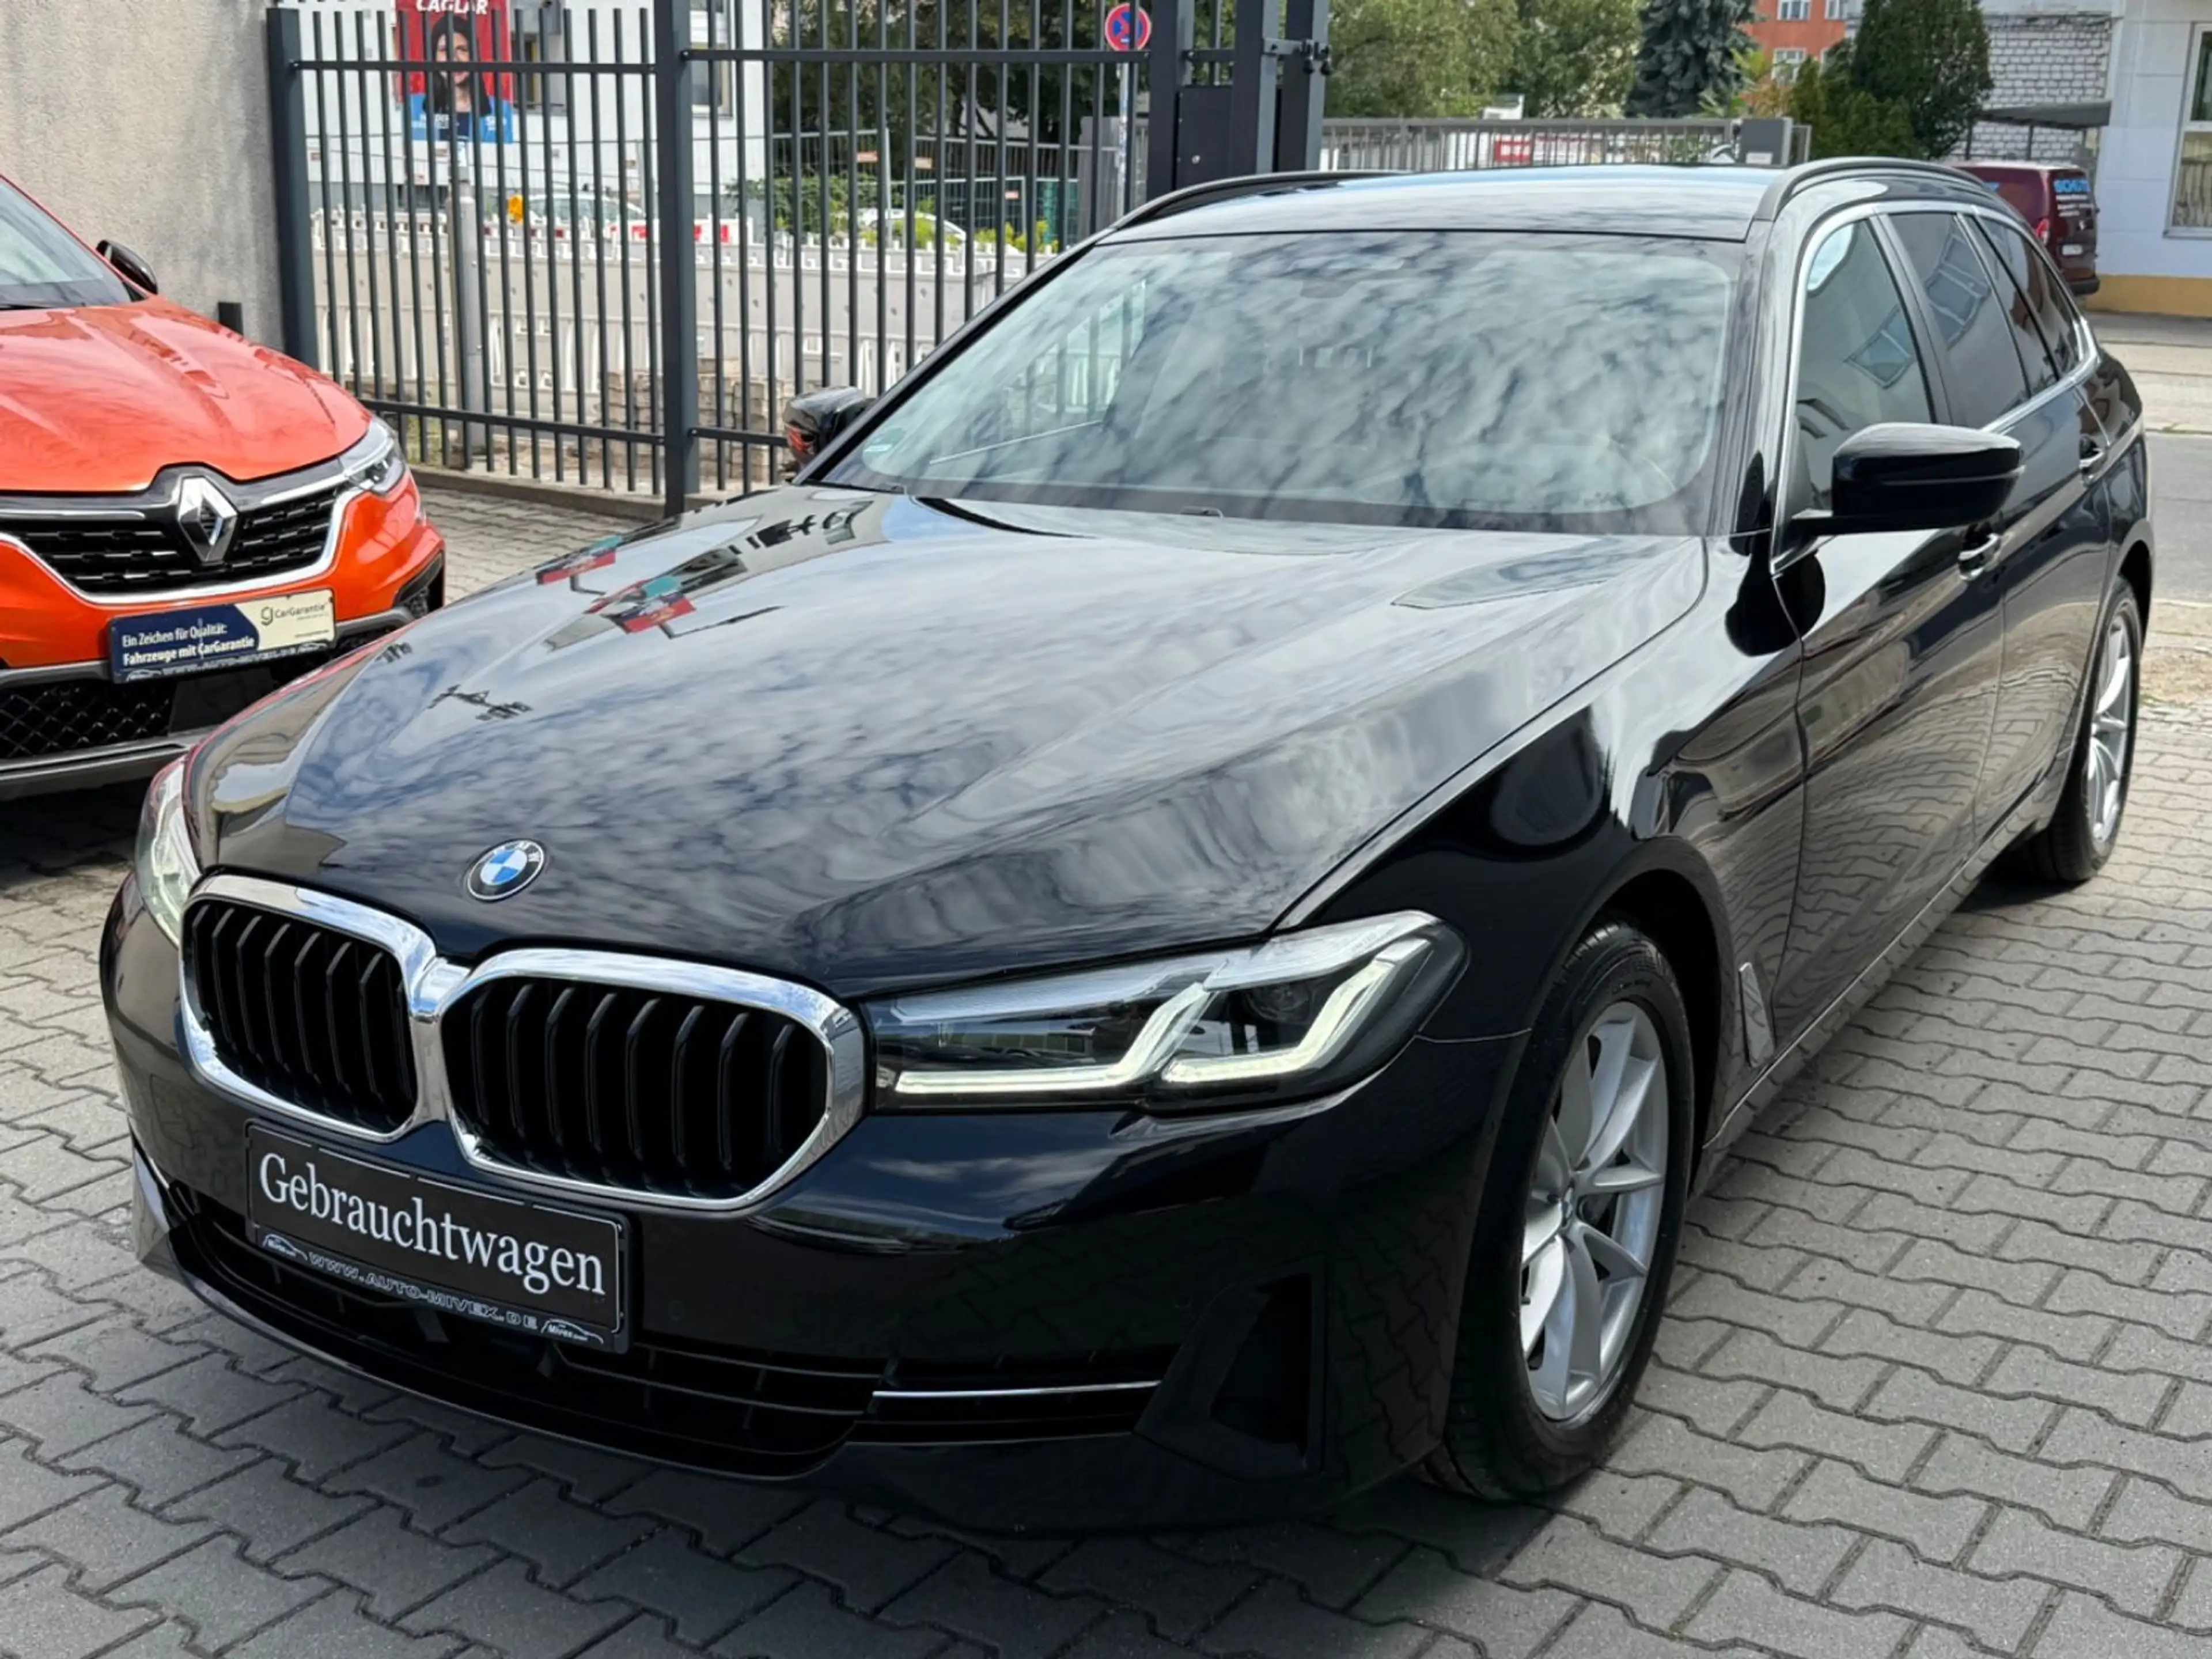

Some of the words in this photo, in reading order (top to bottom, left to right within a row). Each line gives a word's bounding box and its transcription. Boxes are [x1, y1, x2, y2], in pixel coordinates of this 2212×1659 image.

[275, 603, 326, 618] CarGarantie
[122, 635, 138, 647] Ein
[138, 631, 173, 646] Zeichen
[175, 627, 188, 641] für
[123, 649, 177, 666] Fahrzeuge
[178, 645, 197, 657] mit
[198, 636, 255, 653] CarGarantie
[259, 1152, 605, 1295] Gebrauchtwagen
[309, 1252, 538, 1330] WWW.AUTO-MIVEX.DE
